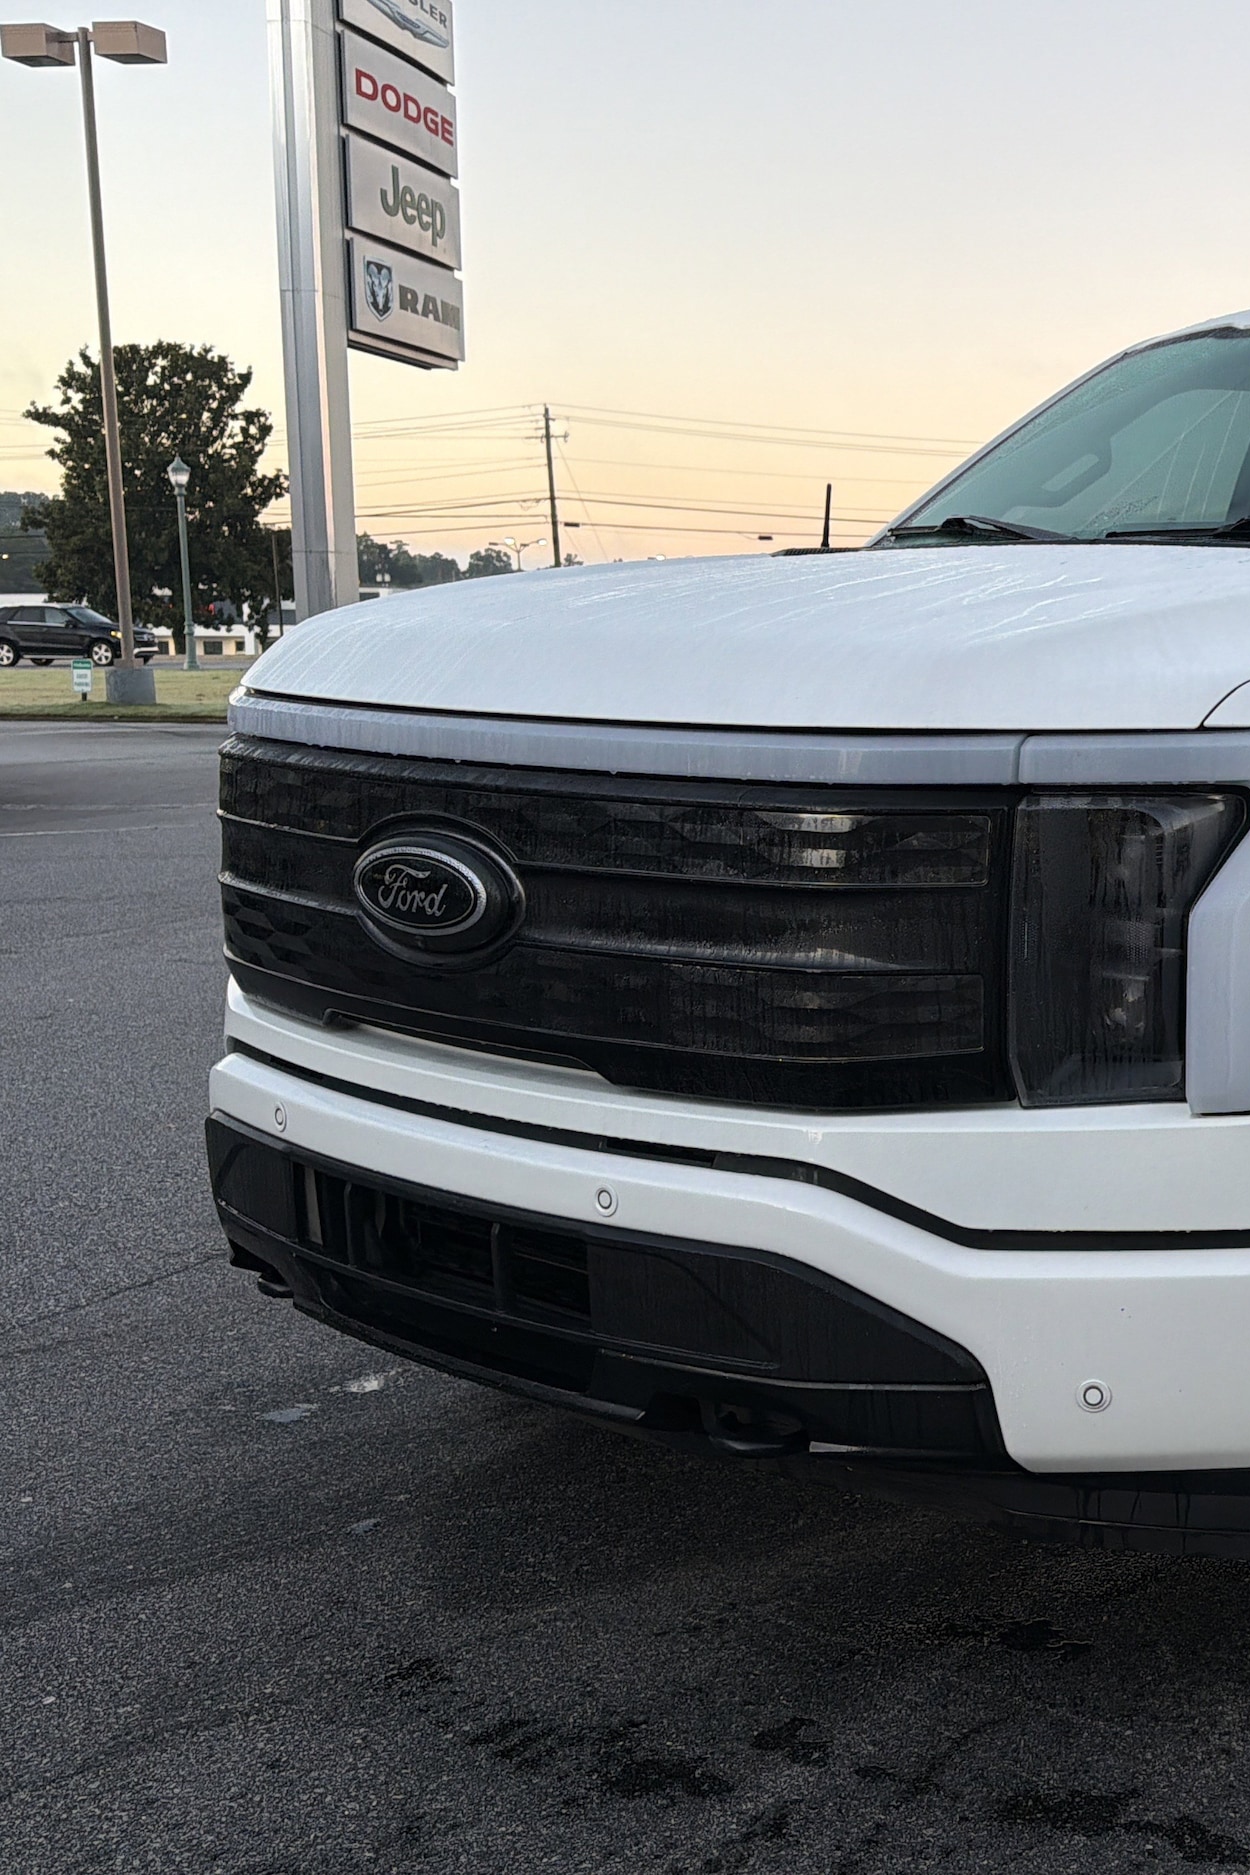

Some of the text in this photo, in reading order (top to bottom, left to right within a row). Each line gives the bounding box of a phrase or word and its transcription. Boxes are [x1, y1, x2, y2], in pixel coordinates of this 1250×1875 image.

[355, 67, 453, 147] DODGE
[380, 164, 446, 247] Jeep
[399, 284, 460, 331] RAM
[378, 864, 448, 917] Ford
